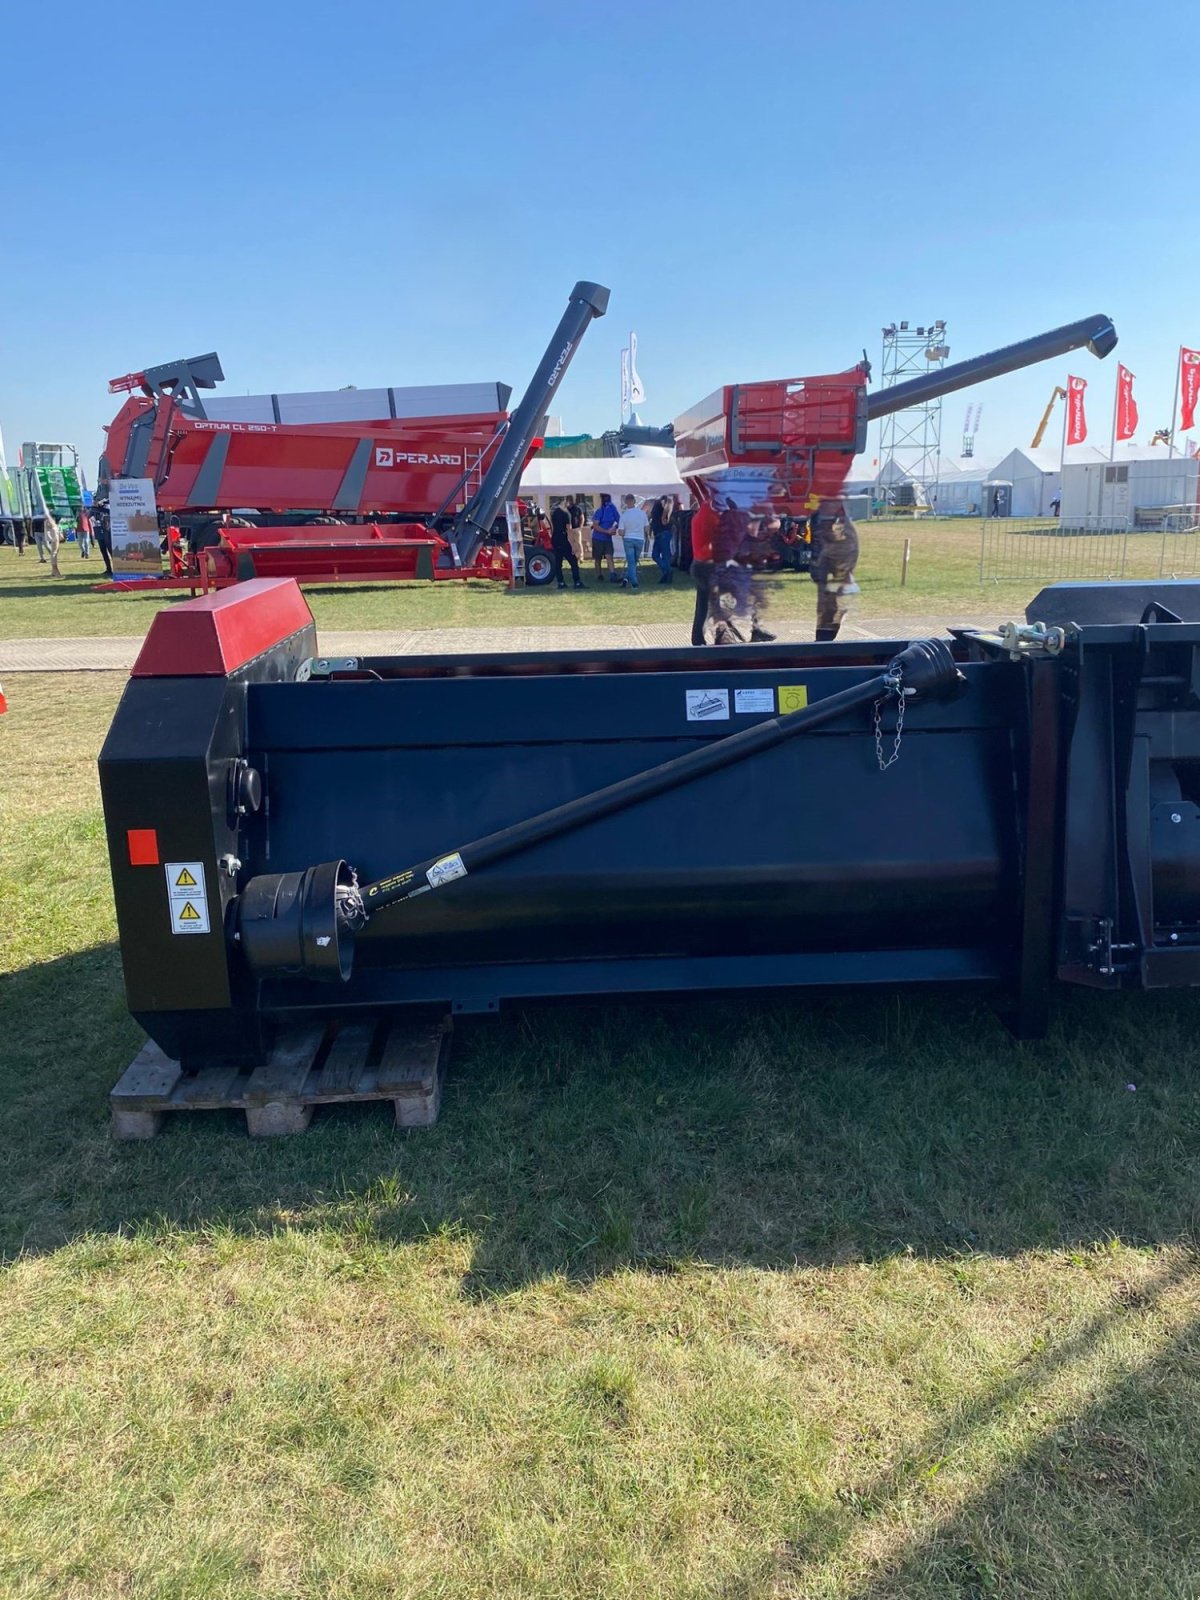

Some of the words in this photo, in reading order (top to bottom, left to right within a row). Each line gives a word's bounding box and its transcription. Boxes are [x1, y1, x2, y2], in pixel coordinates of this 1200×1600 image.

[547, 341, 573, 387] PERARD
[194, 422, 230, 430] OPTIUM
[232, 423, 246, 431] CL
[395, 452, 462, 465] PERARD
